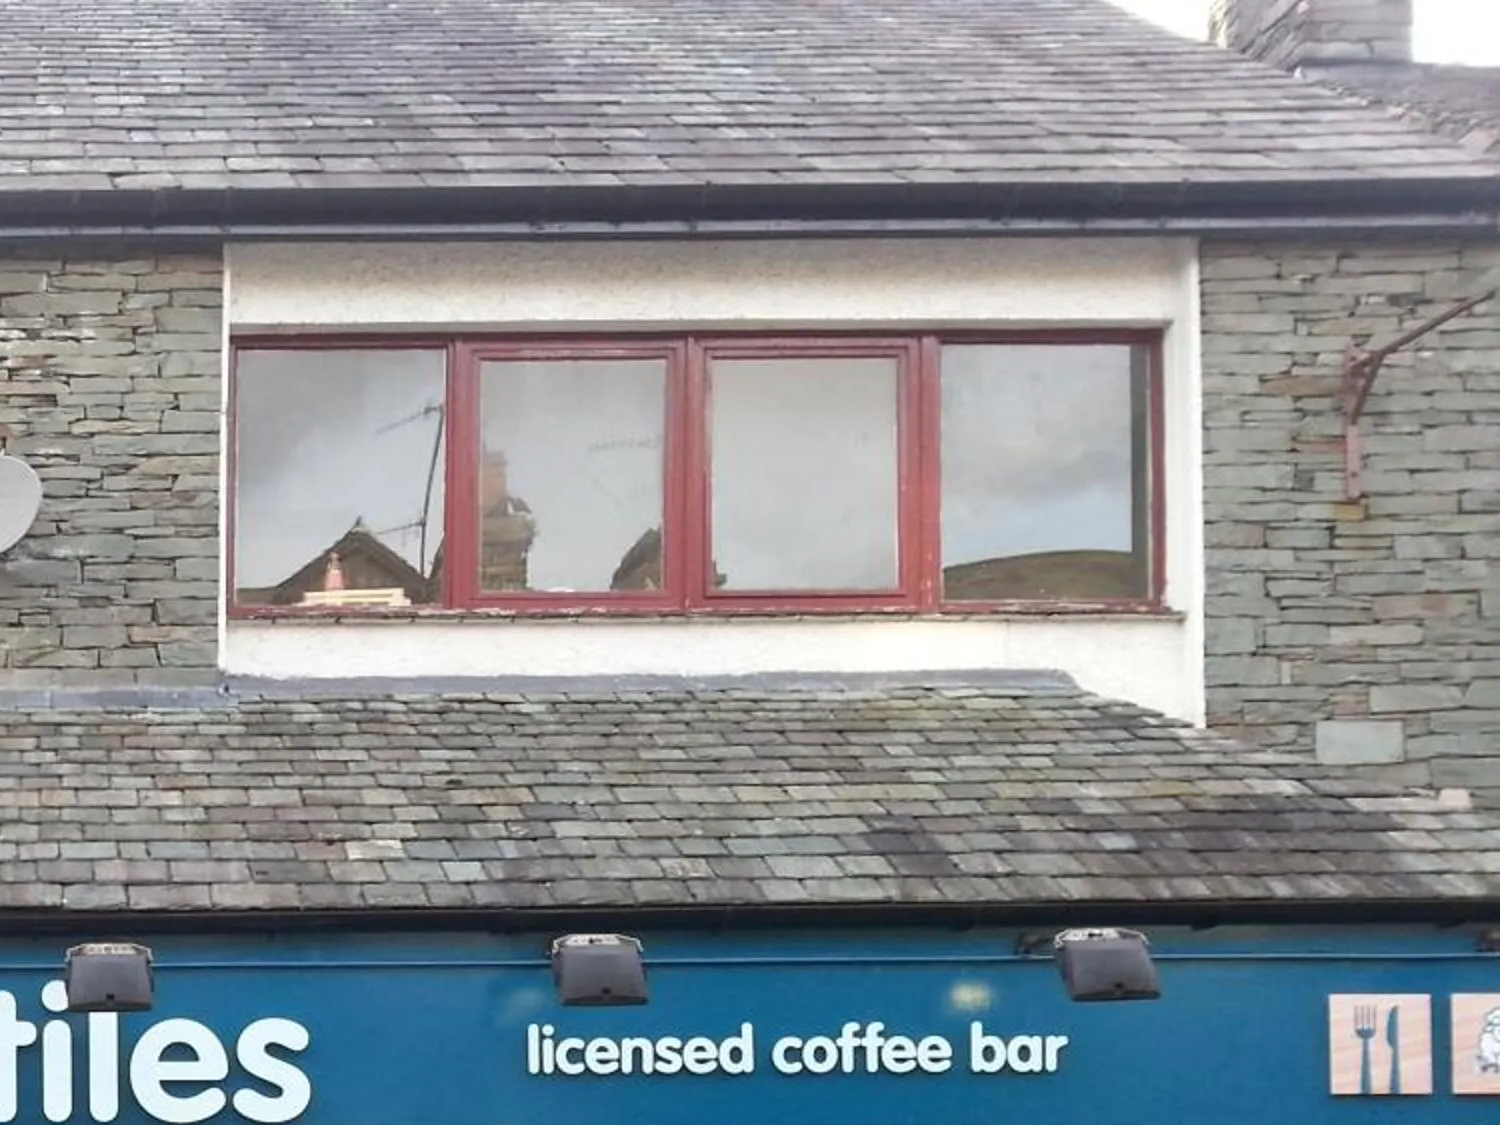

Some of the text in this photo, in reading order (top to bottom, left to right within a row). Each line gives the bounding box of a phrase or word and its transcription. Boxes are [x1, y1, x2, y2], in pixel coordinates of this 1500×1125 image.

[527, 1021, 1069, 1075] licensed coffee bar
